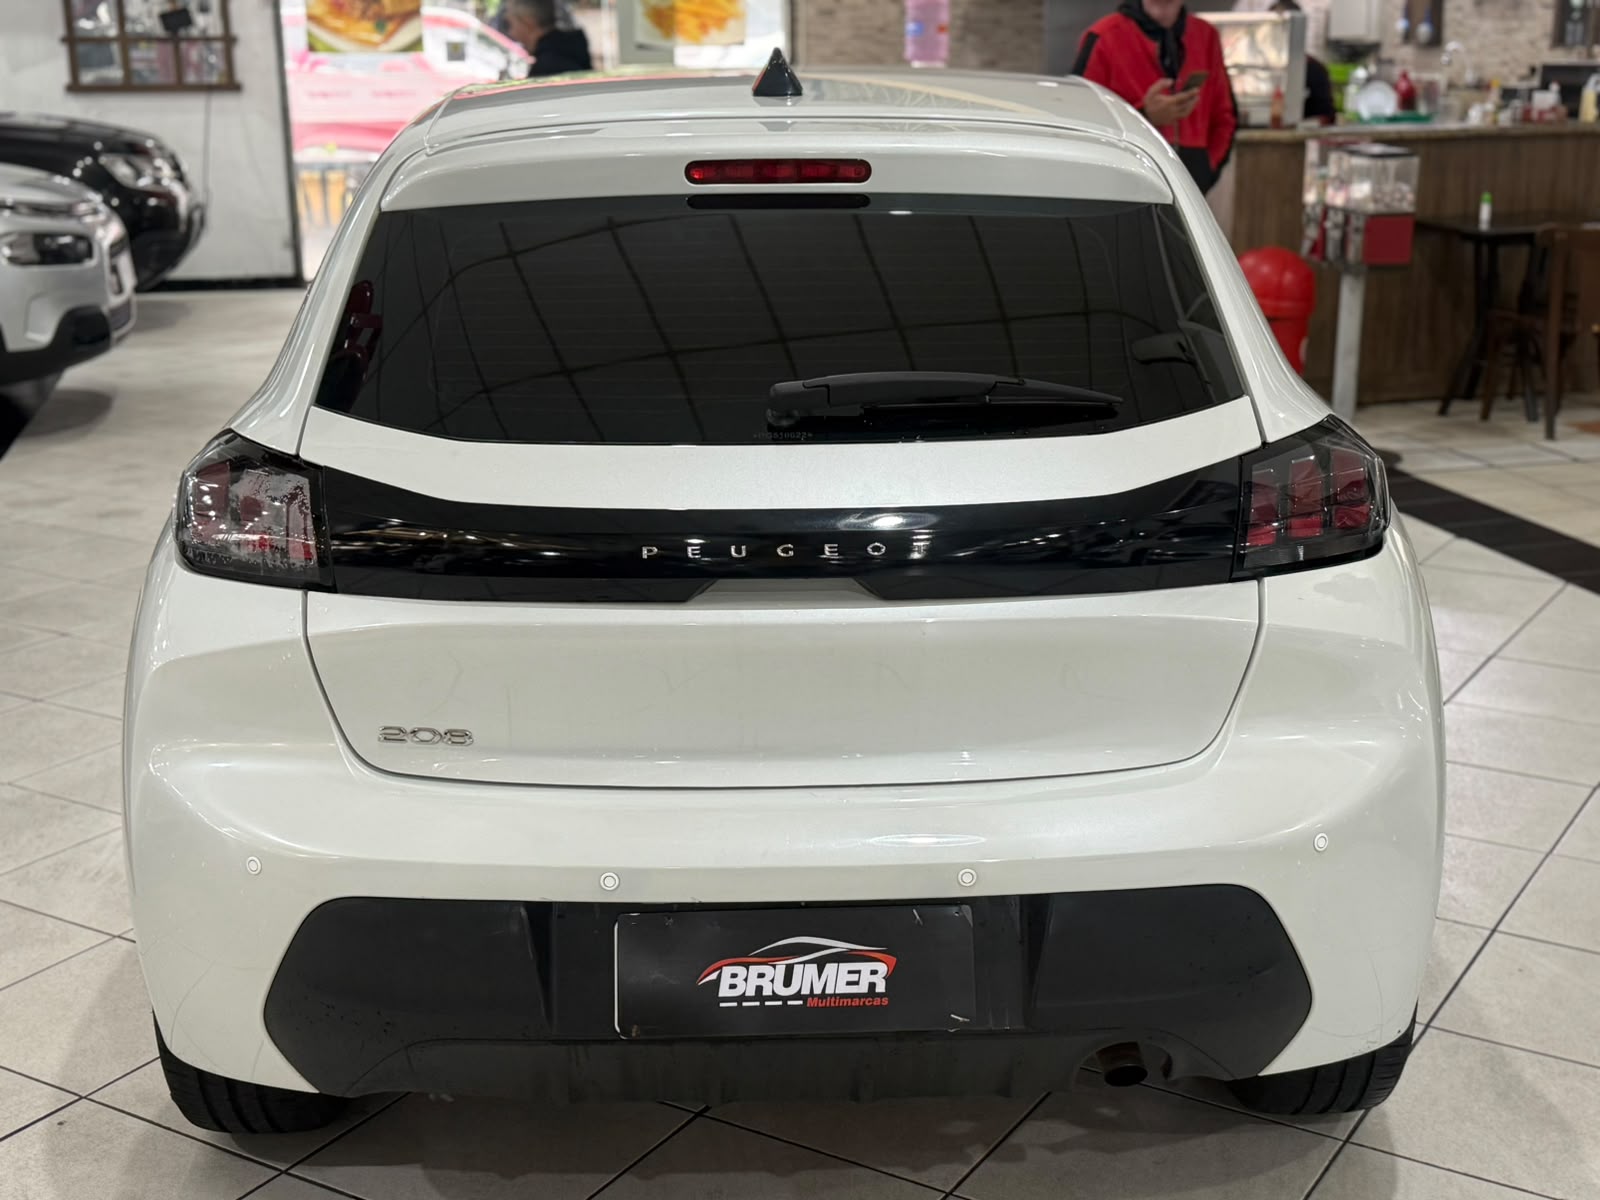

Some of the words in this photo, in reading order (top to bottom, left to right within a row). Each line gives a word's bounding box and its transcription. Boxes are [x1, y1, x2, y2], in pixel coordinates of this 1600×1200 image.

[641, 542, 930, 559] PEUGEOT
[378, 726, 474, 746] 208
[718, 962, 888, 998] BRUMER
[806, 996, 889, 1008] Multimarcas
